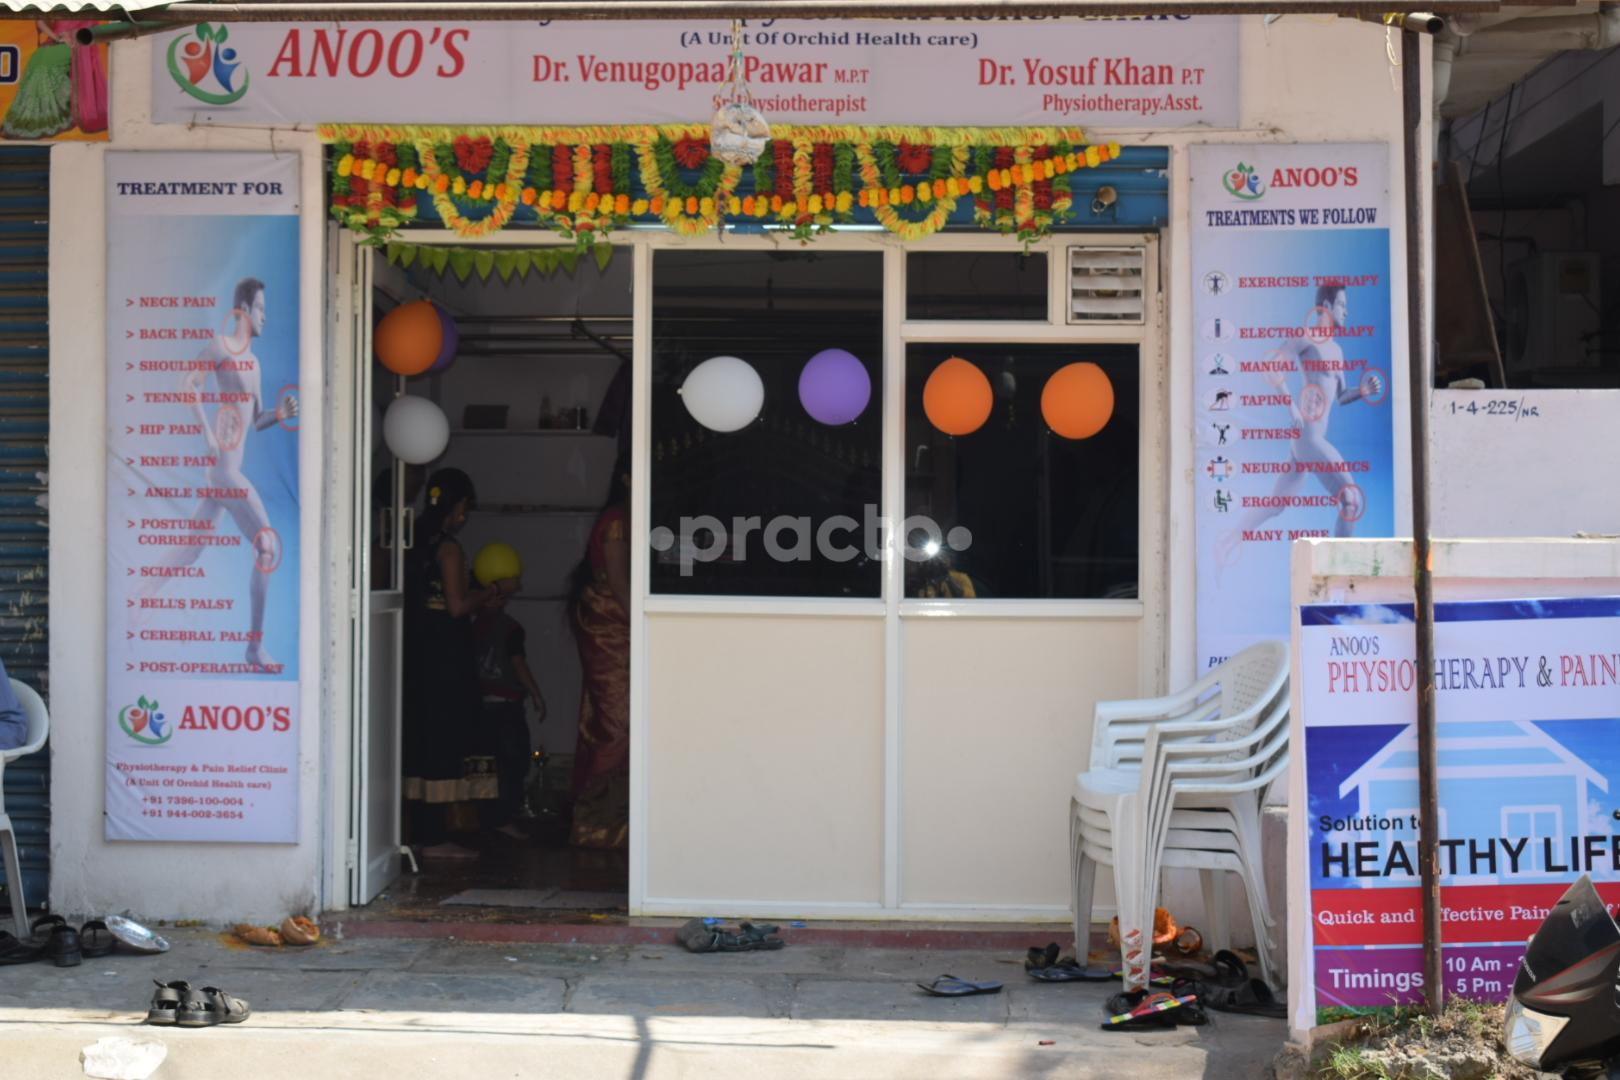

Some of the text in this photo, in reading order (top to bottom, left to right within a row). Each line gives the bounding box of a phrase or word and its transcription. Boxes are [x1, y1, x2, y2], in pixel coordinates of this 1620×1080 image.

[680, 31, 978, 49] (A Unt Of Orchid Health care)
[268, 28, 470, 79] ANOO'S
[532, 55, 569, 82] Dr.
[744, 55, 827, 83] Pawar
[834, 69, 869, 84] M.P.T
[978, 58, 1205, 86] Dr. Yosuf Khan P.T
[1042, 94, 1203, 115] Physiotherapy.Asst.
[1270, 167, 1358, 188] ANOO'S
[117, 182, 284, 196] TREATMENT FOR
[1207, 207, 1377, 227] TREATMENTS WE FOLLOW
[1238, 274, 1379, 289] EXERCISE THERAPY
[139, 297, 216, 308] NECK PAIN
[139, 329, 215, 340] BACK PAIN
[1239, 325, 1376, 339] ELECTRO THERAPY
[139, 361, 254, 372] SHOULDER PAIN
[1240, 359, 1369, 372] MANUAL THERAPY
[144, 393, 250, 404] TENNIS ELBOW
[1240, 395, 1292, 406] TAPING
[139, 424, 202, 436] HIP PAIN
[1241, 428, 1302, 440] FITNESS
[140, 457, 217, 468] KNEE PAIN
[1241, 461, 1370, 474] NEURO DYNAMICS
[145, 488, 249, 499] ANKLE SPRAIN
[1242, 495, 1338, 508] ERGONOMICS
[140, 519, 215, 530] POSTURAL
[1242, 530, 1283, 541] MANY
[140, 566, 206, 578] SCIATICA
[140, 598, 234, 610] BELL'S PALSY
[140, 630, 264, 642] CEREBRAL PALSY
[1330, 636, 1380, 656] ANOO'S
[140, 662, 261, 674] POST-OPERATIVE
[1328, 655, 1529, 693] PHYSIOHERAPY
[1536, 655, 1553, 688] &
[178, 705, 291, 732] ANOO'S
[116, 762, 288, 775] Physiotherapy & Pain Relief Clinic
[125, 777, 272, 790] (A Unit Of Orchid Health care)
[1319, 814, 1421, 832] Solution t
[1318, 909, 1375, 926] Quick
[1380, 908, 1416, 924] and
[1446, 956, 1466, 973] 10
[1471, 957, 1501, 973] Am
[1328, 968, 1424, 992] Timings
[1456, 977, 1467, 994] 5
[1472, 977, 1501, 993] Pm
